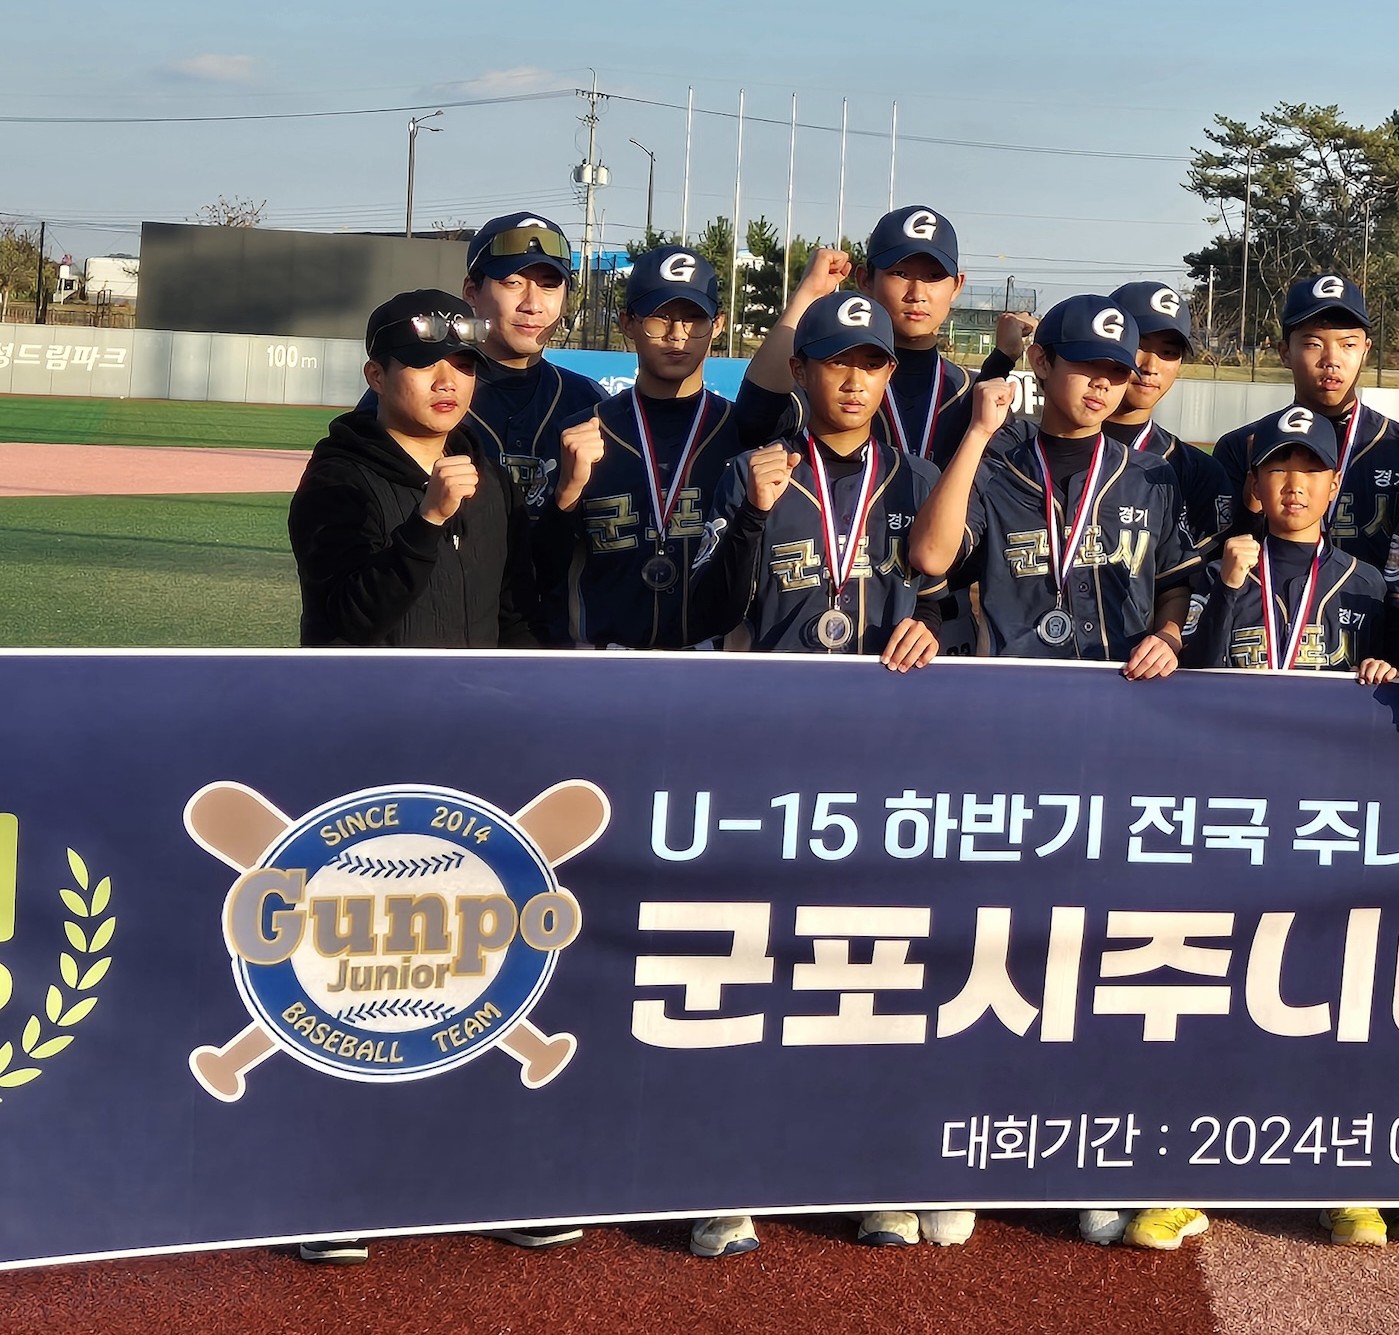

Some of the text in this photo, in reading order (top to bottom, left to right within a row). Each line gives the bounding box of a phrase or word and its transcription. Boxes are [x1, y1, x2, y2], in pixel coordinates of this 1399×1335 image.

[903, 210, 937, 240] G
[659, 252, 696, 283] G
[1150, 288, 1180, 318] G
[1312, 275, 1344, 299] G
[837, 296, 872, 328] G
[1091, 308, 1125, 341] G
[1278, 407, 1314, 434] G
[1118, 506, 1149, 527] 경기
[1338, 608, 1366, 630] 경기
[319, 803, 493, 847] SINCE 2014
[651, 791, 859, 862] U-15
[884, 789, 1104, 861] 하반기
[1127, 796, 1270, 865] 전국
[222, 865, 583, 977] Gunpo
[326, 957, 454, 993] Junior
[281, 1001, 502, 1063] BASEBALL TEAM
[941, 1113, 1141, 1170] 대회기간
[1188, 1113, 1374, 1168] 2024년
